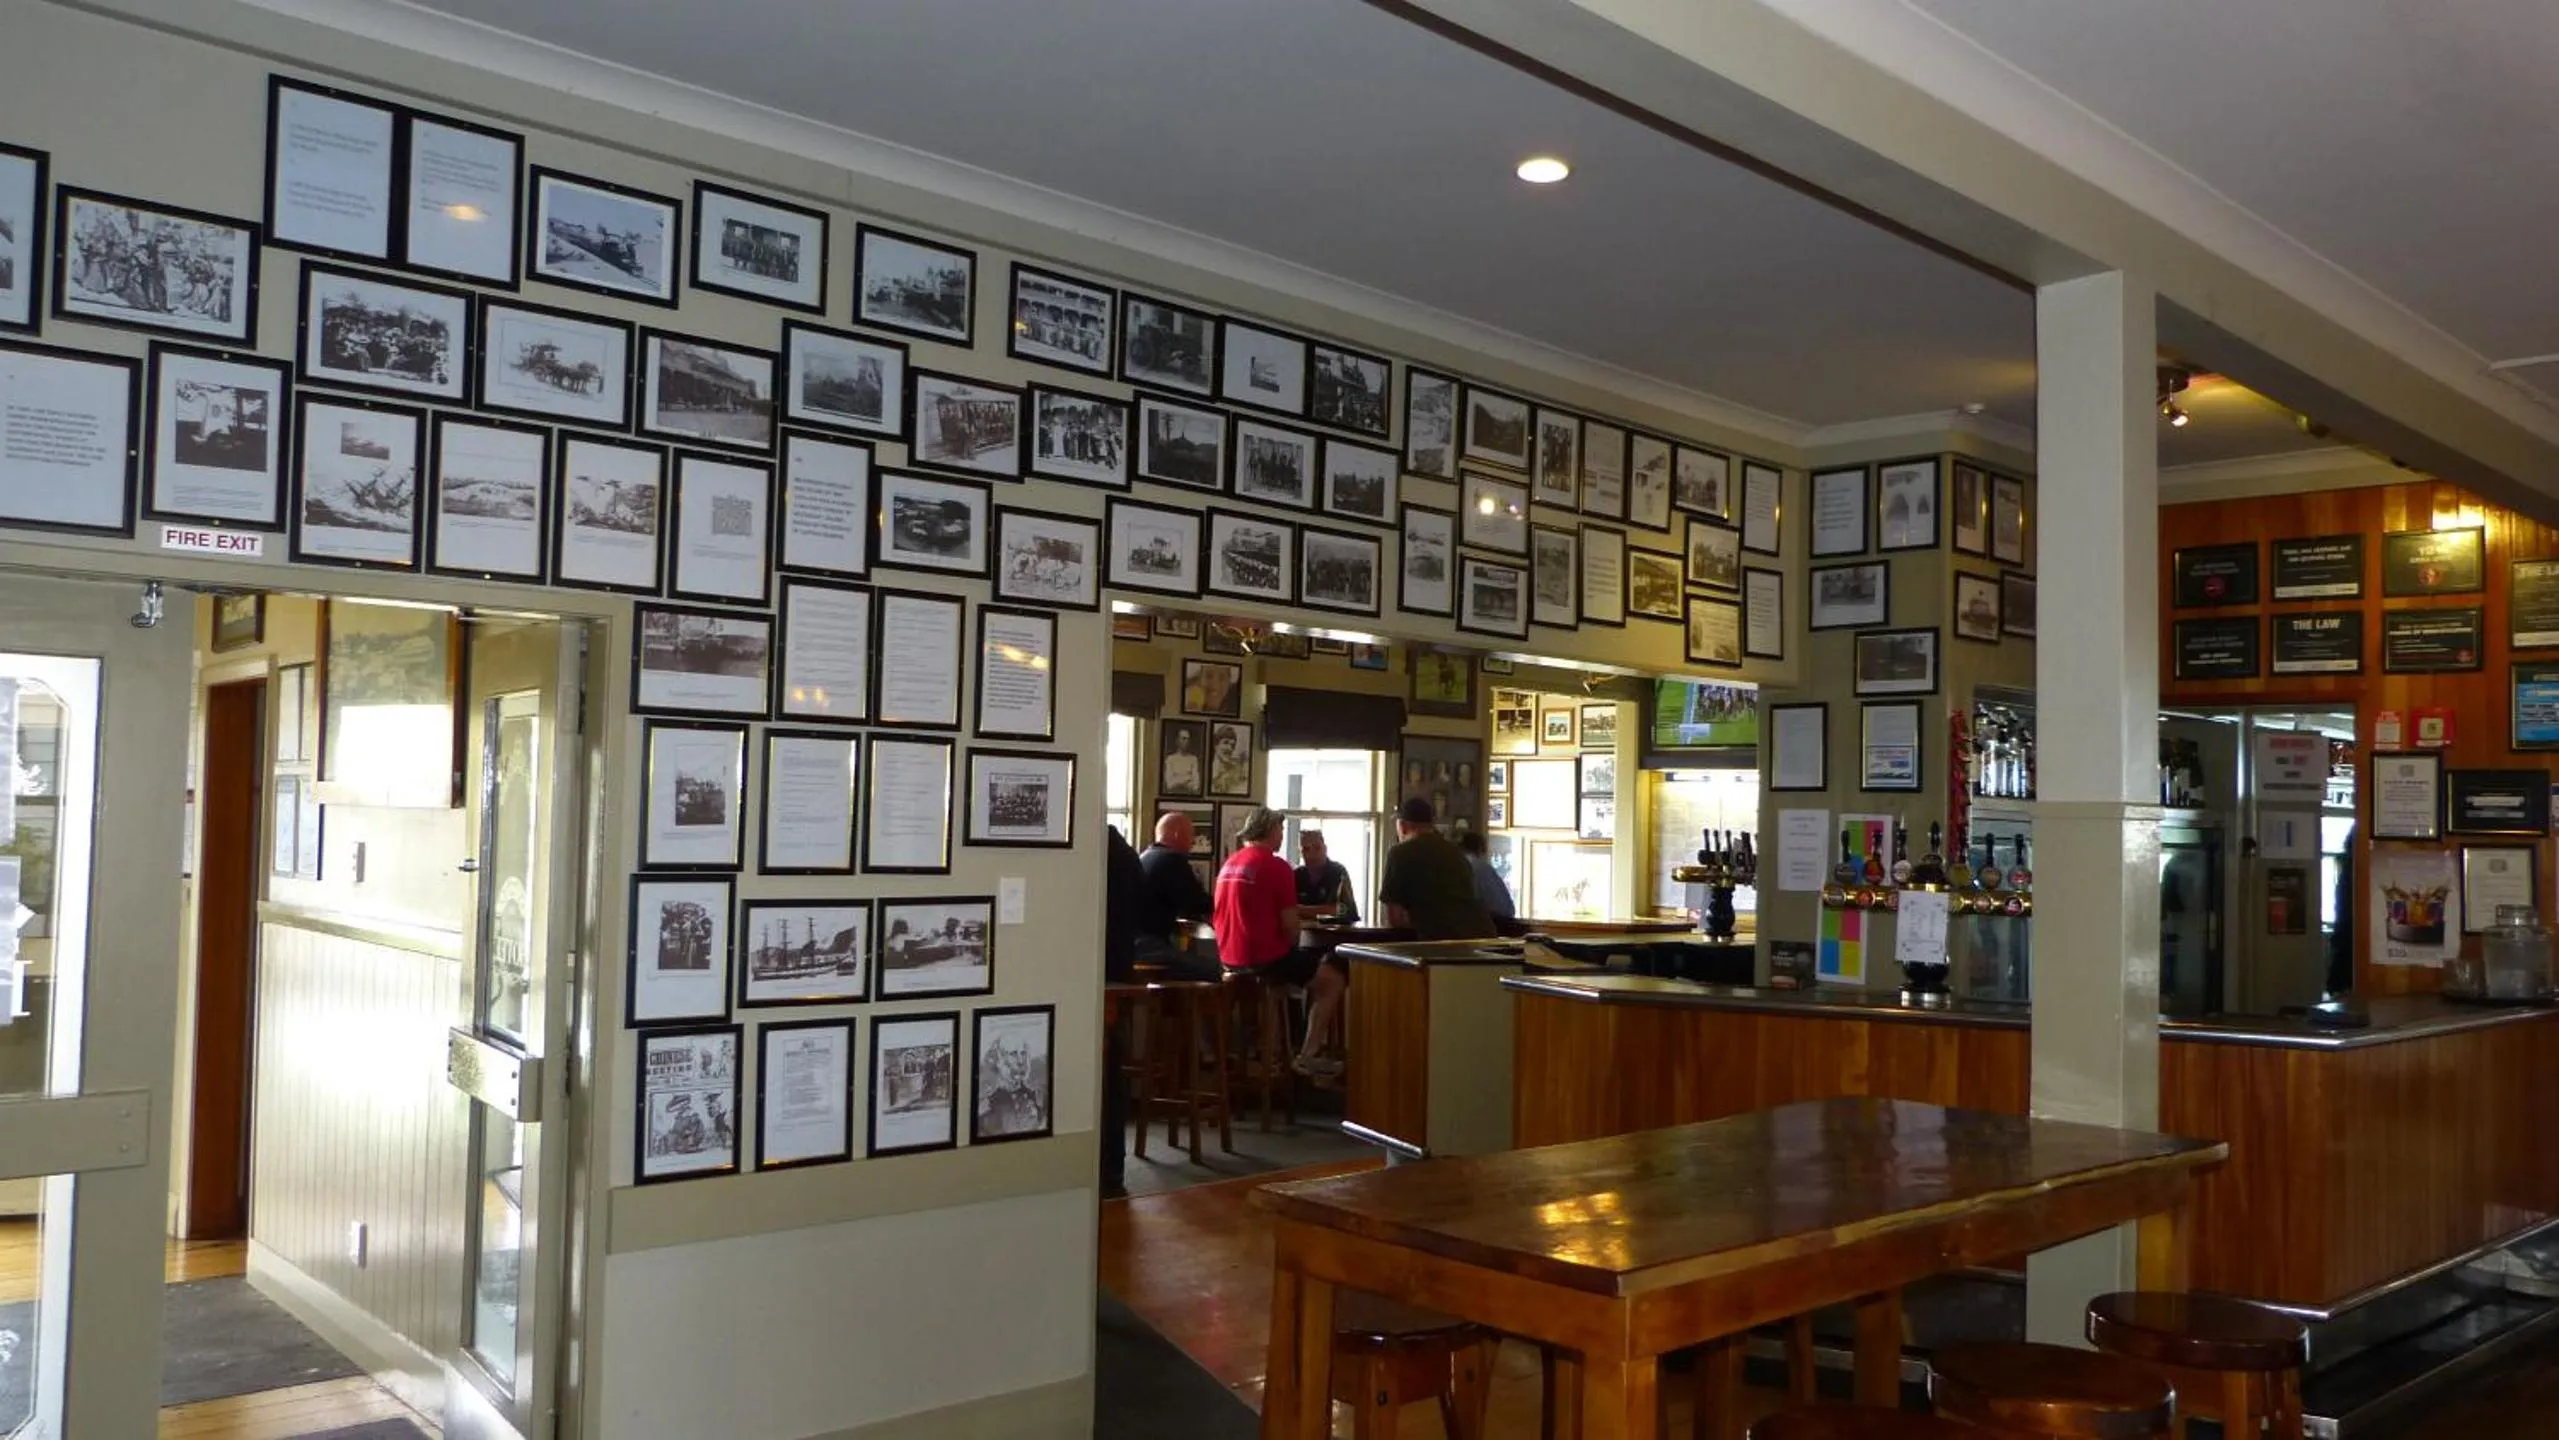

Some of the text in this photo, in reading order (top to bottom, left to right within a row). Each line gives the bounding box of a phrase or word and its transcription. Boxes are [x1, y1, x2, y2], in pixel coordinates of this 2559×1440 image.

[166, 530, 259, 551] FIRE EXIT
[2292, 617, 2341, 630] THE LAW
